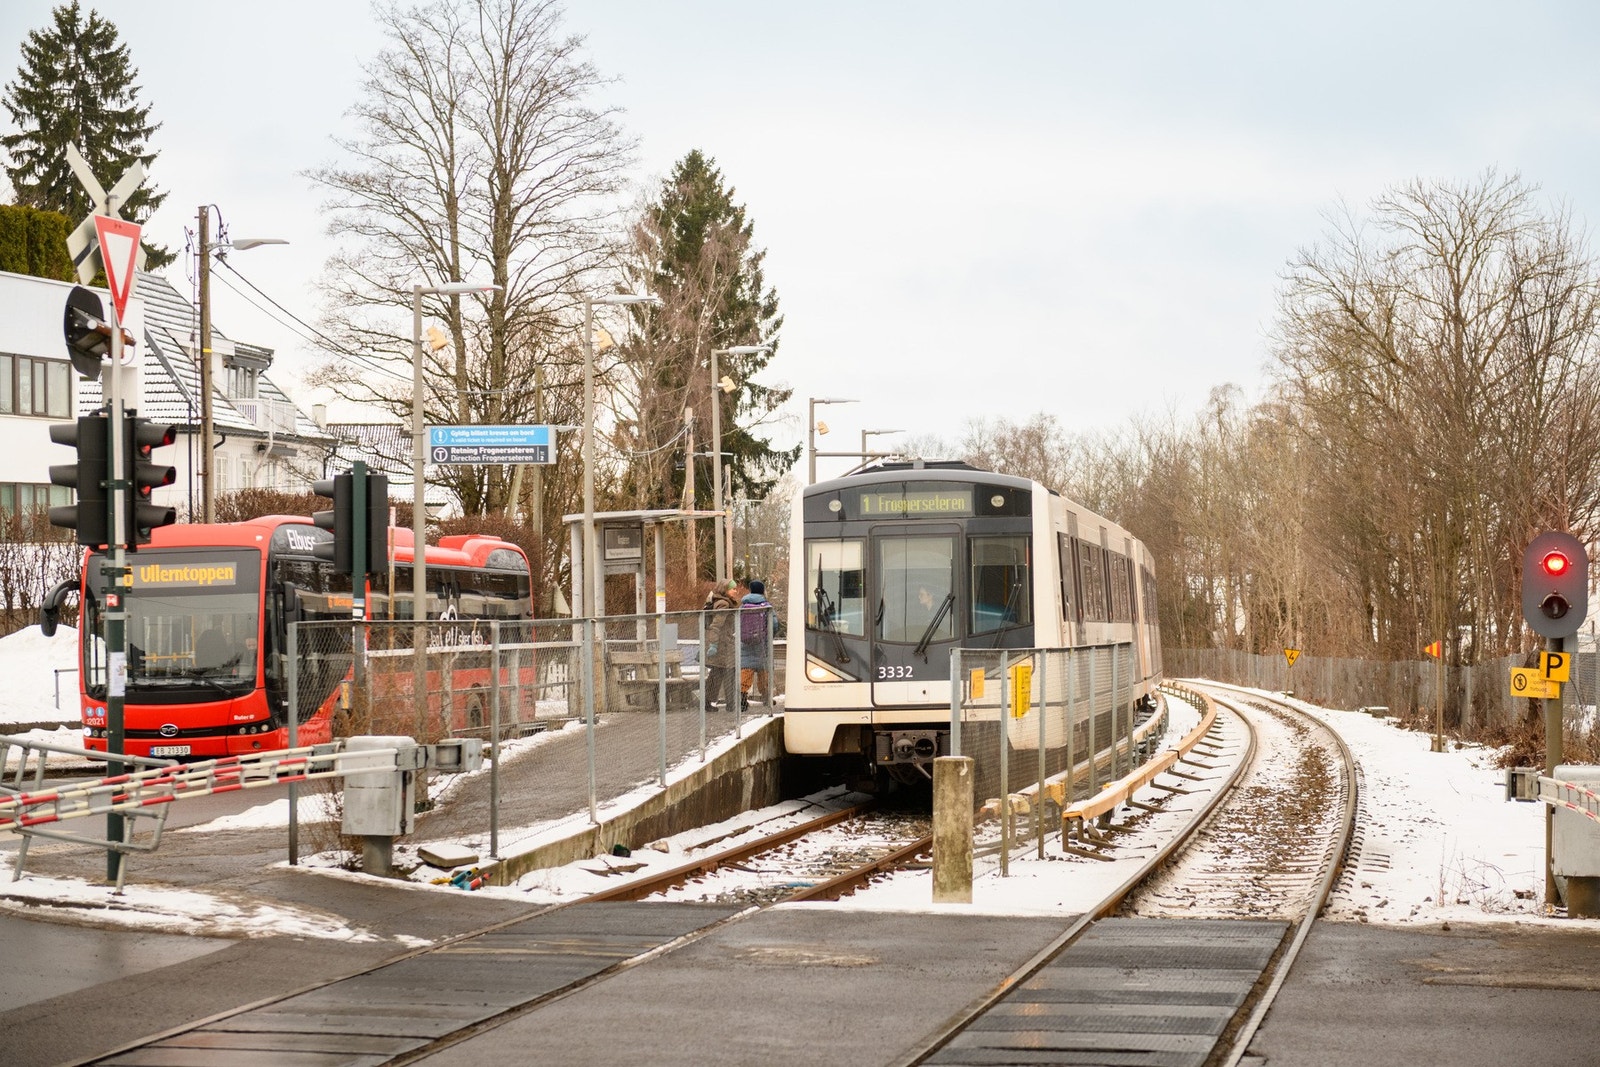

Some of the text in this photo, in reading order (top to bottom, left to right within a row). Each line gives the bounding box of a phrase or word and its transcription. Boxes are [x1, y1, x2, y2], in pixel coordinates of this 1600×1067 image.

[450, 447, 478, 455] Retning
[479, 447, 535, 455] Frognerseteren
[482, 454, 534, 462] Frognerseteren
[863, 494, 966, 513] 1 Frognerseteren
[140, 564, 234, 585] Ullerntoppen
[878, 665, 914, 679] 3332
[1546, 653, 1563, 678] P
[167, 746, 189, 754] 21330
